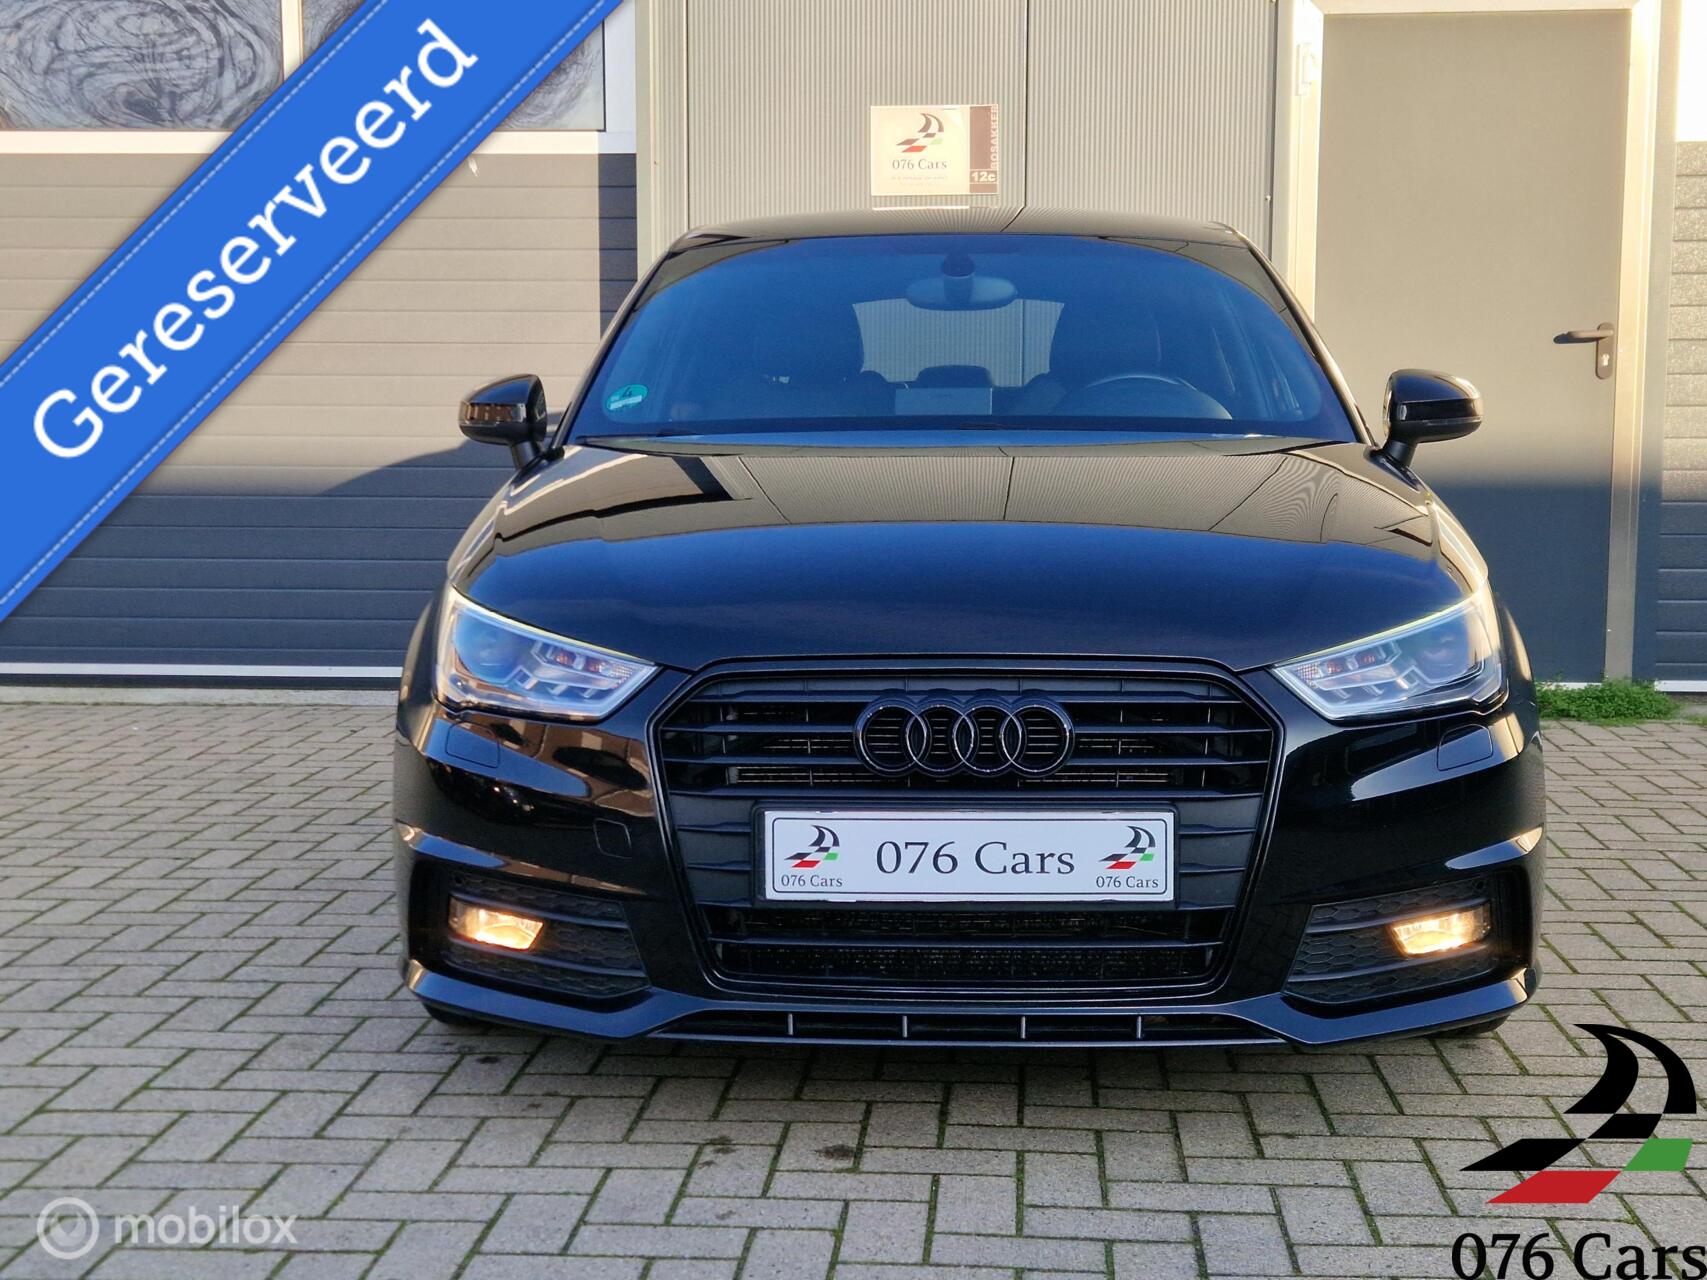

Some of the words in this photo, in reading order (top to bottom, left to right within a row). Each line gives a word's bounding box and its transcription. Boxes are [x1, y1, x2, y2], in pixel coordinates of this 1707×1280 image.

[892, 159, 914, 170] 076
[918, 159, 947, 170] Cars
[971, 171, 996, 182] 12c
[876, 840, 959, 875] 076
[974, 841, 1075, 875] Cars
[781, 874, 806, 887] 076
[810, 874, 843, 887] Cars
[1096, 876, 1121, 888] 076
[1125, 876, 1159, 888] Cars
